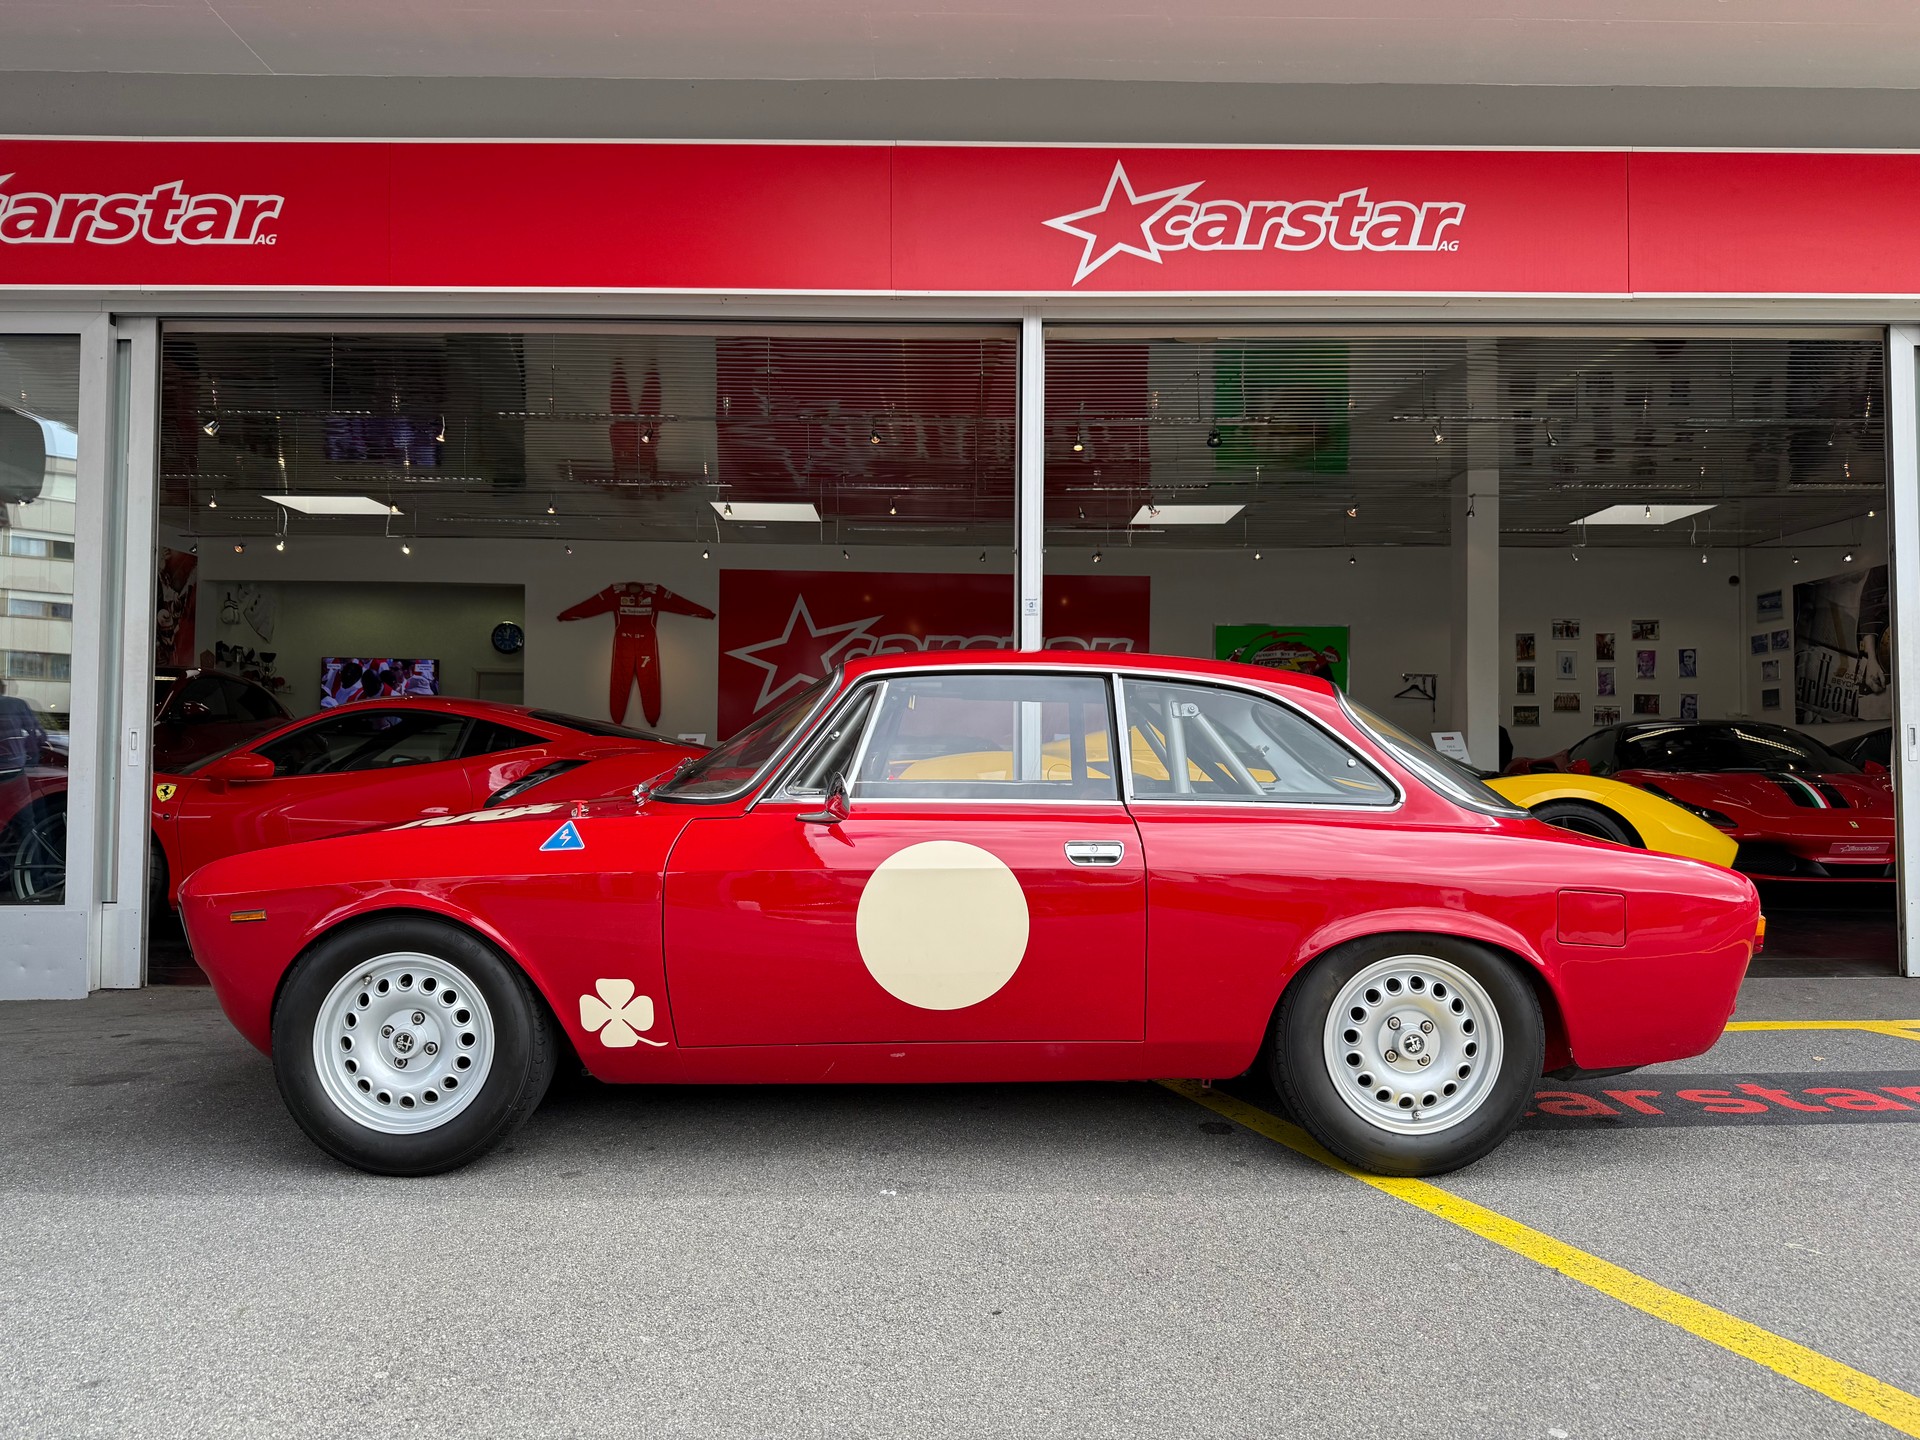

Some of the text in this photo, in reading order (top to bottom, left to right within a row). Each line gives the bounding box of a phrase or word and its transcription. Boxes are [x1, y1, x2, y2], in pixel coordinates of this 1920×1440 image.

[0, 180, 285, 245] arstar AG
[1146, 187, 1466, 252] carstar AG
[1796, 653, 1859, 716] arlboro
[1524, 1083, 1920, 1117] arstar
